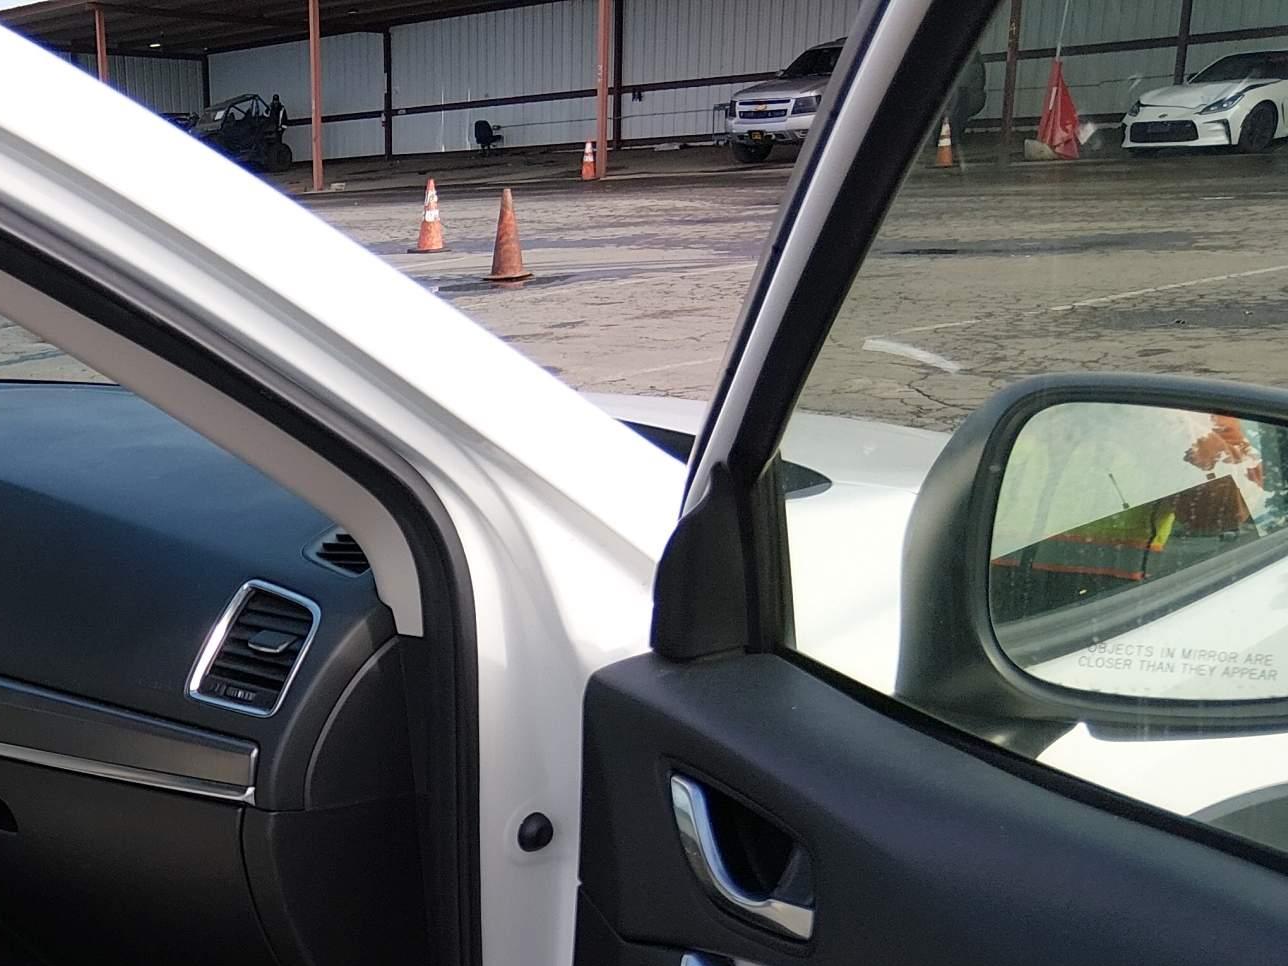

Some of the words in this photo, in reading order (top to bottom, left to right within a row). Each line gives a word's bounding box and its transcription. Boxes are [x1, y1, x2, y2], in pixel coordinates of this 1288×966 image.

[1087, 643, 1154, 658] OBJECTS
[1159, 647, 1177, 658] IN
[1181, 648, 1239, 663] MIRROR
[1243, 653, 1273, 666] ARE
[1078, 655, 1132, 670] CLOSER
[1139, 659, 1177, 673] THAN
[1181, 663, 1217, 677] THEY
[1221, 666, 1278, 681] APPEAR
